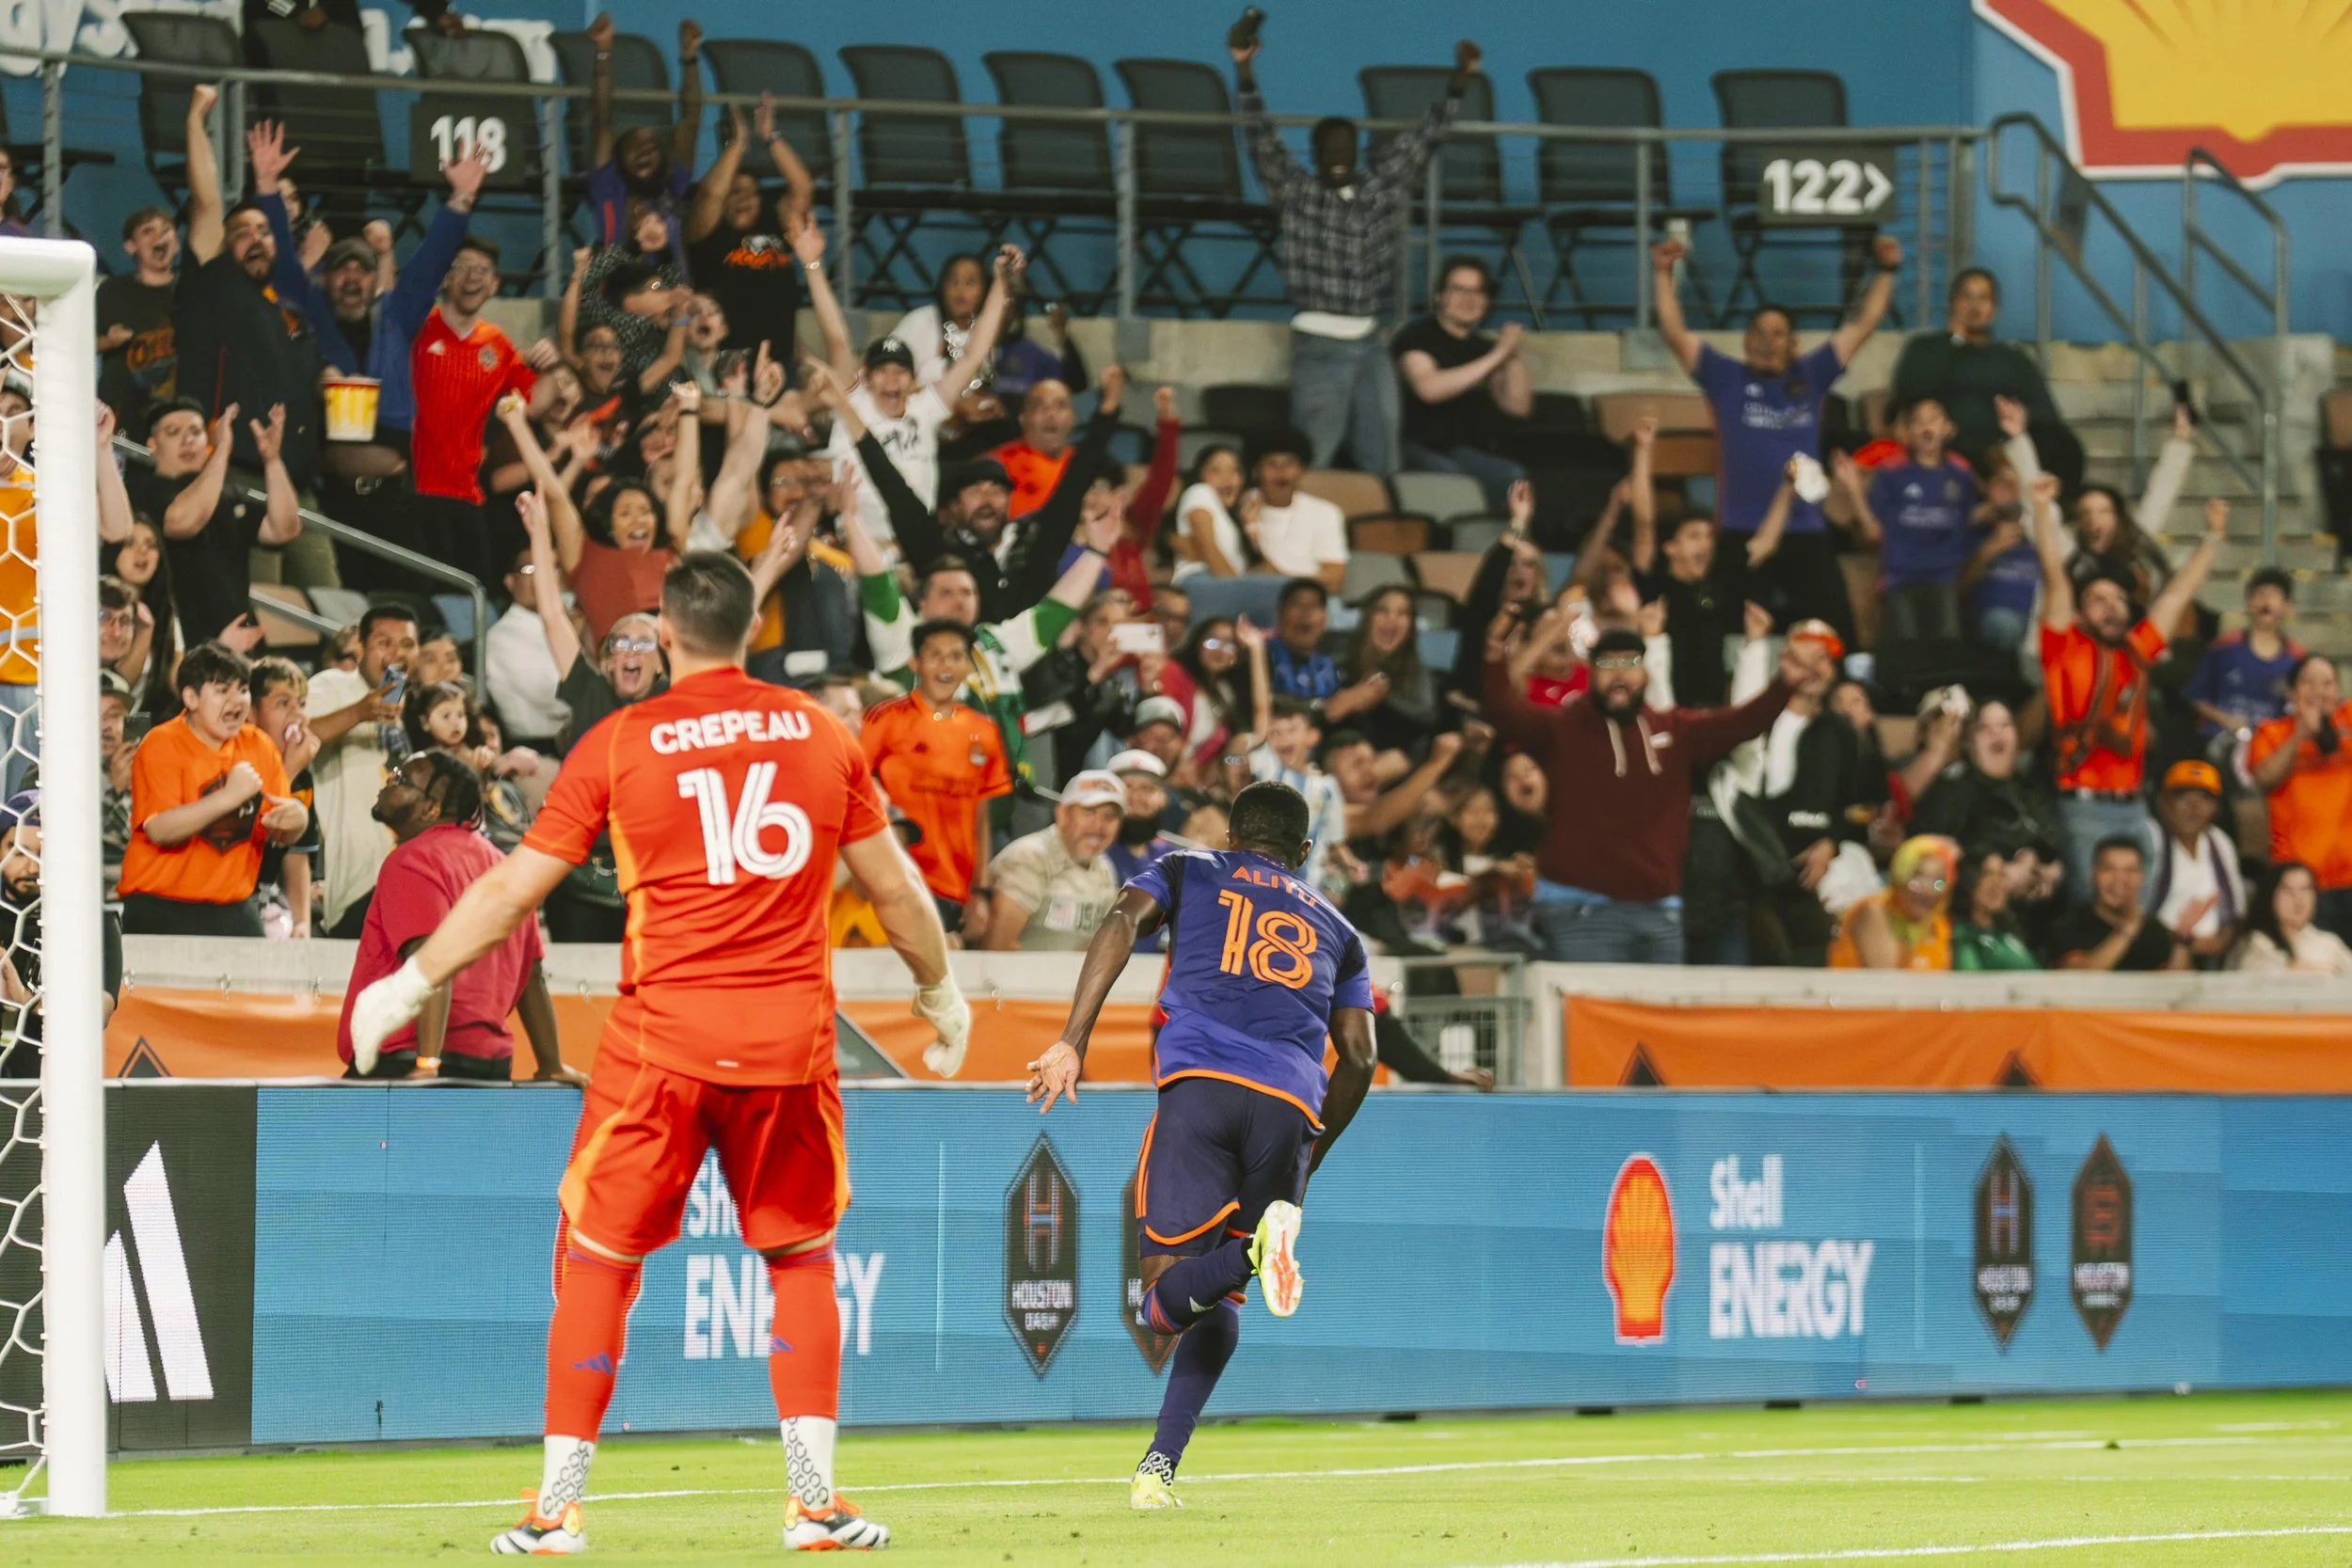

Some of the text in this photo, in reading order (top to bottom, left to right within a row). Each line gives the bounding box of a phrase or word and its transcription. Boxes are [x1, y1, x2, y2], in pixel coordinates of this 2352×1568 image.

[430, 115, 507, 173] 118
[1763, 158, 1864, 214] 122
[650, 709, 812, 754] CREPEAU
[676, 761, 813, 885] 16
[1218, 889, 1318, 990] 18
[1709, 1153, 1783, 1231] Shell
[1011, 1279, 1073, 1309] HOUSTON
[1708, 1239, 1876, 1340] ENERGY
